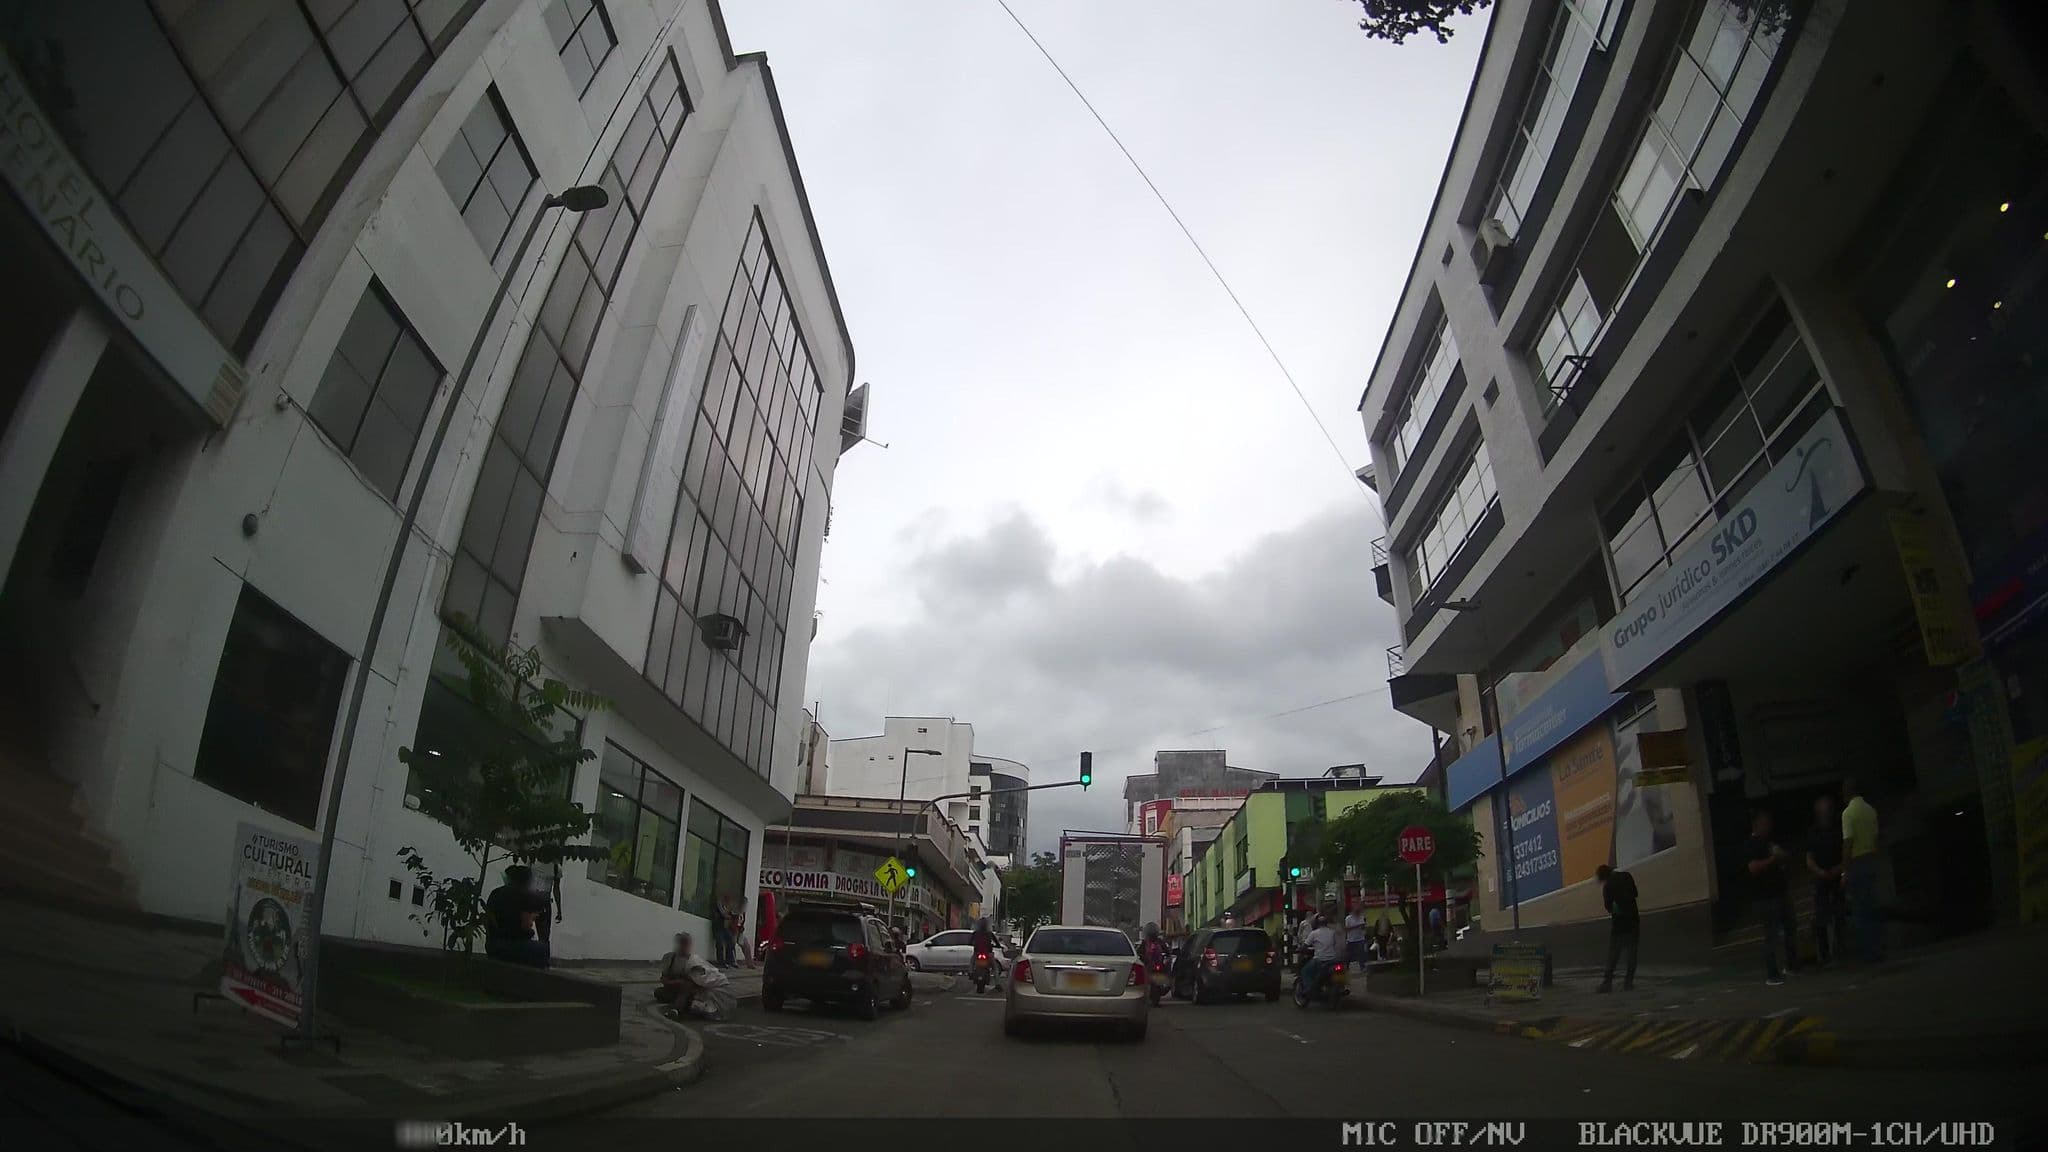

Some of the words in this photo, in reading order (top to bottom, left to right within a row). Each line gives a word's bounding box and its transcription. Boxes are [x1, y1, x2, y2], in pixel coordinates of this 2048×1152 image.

[1614, 605, 1658, 649] Grupo
[1657, 558, 1712, 618] jurídico
[1710, 507, 1758, 566] SKD
[1401, 835, 1432, 853] PARE
[243, 844, 313, 880] CULTURAL
[759, 869, 829, 889] ECONOMIA
